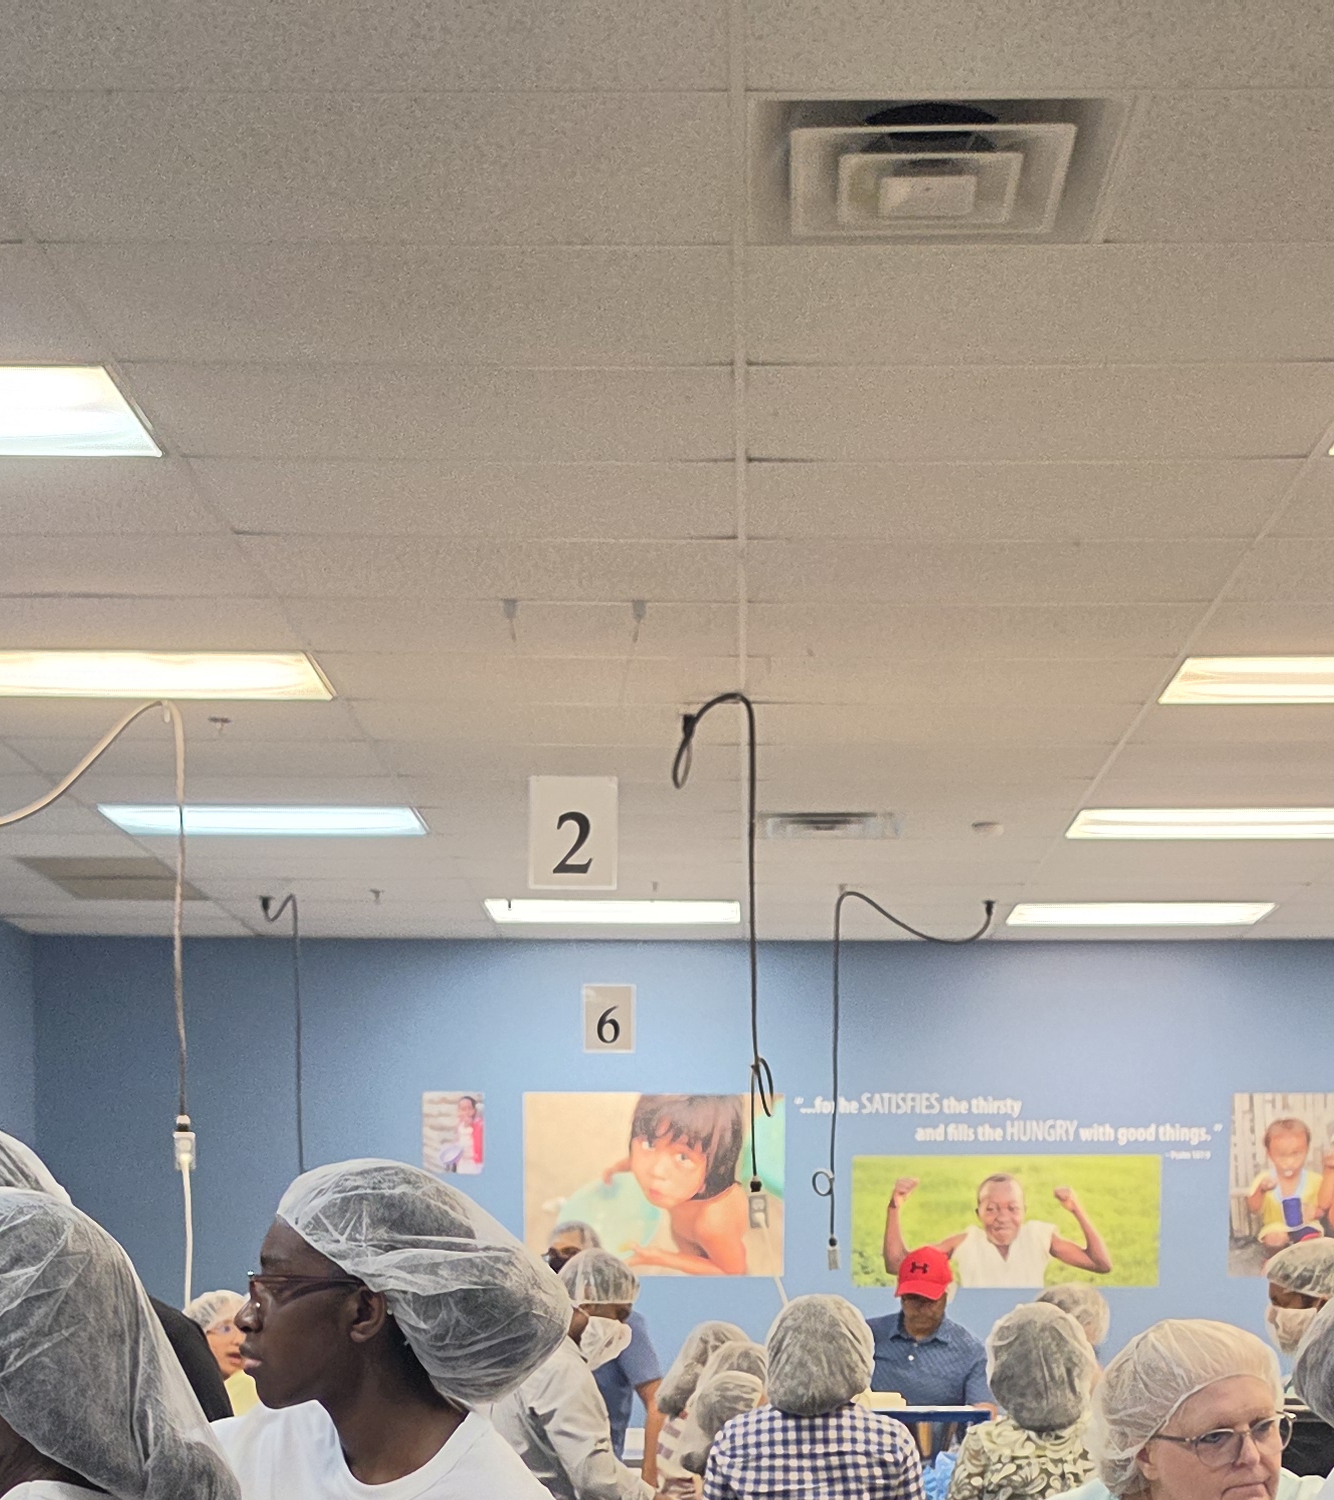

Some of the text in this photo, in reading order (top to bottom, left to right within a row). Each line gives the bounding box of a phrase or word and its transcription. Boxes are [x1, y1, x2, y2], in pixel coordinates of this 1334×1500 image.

[553, 811, 593, 874] 2
[597, 1005, 620, 1043] 6
[861, 1092, 940, 1114] SATISFIES
[942, 1096, 969, 1114] the
[971, 1096, 1022, 1118] thirsty
[915, 1123, 945, 1142] and
[947, 1122, 975, 1142] fills
[977, 1122, 1004, 1142] the
[1006, 1119, 1078, 1142] HUNGRY
[1079, 1123, 1115, 1142] with
[1117, 1123, 1156, 1146] good
